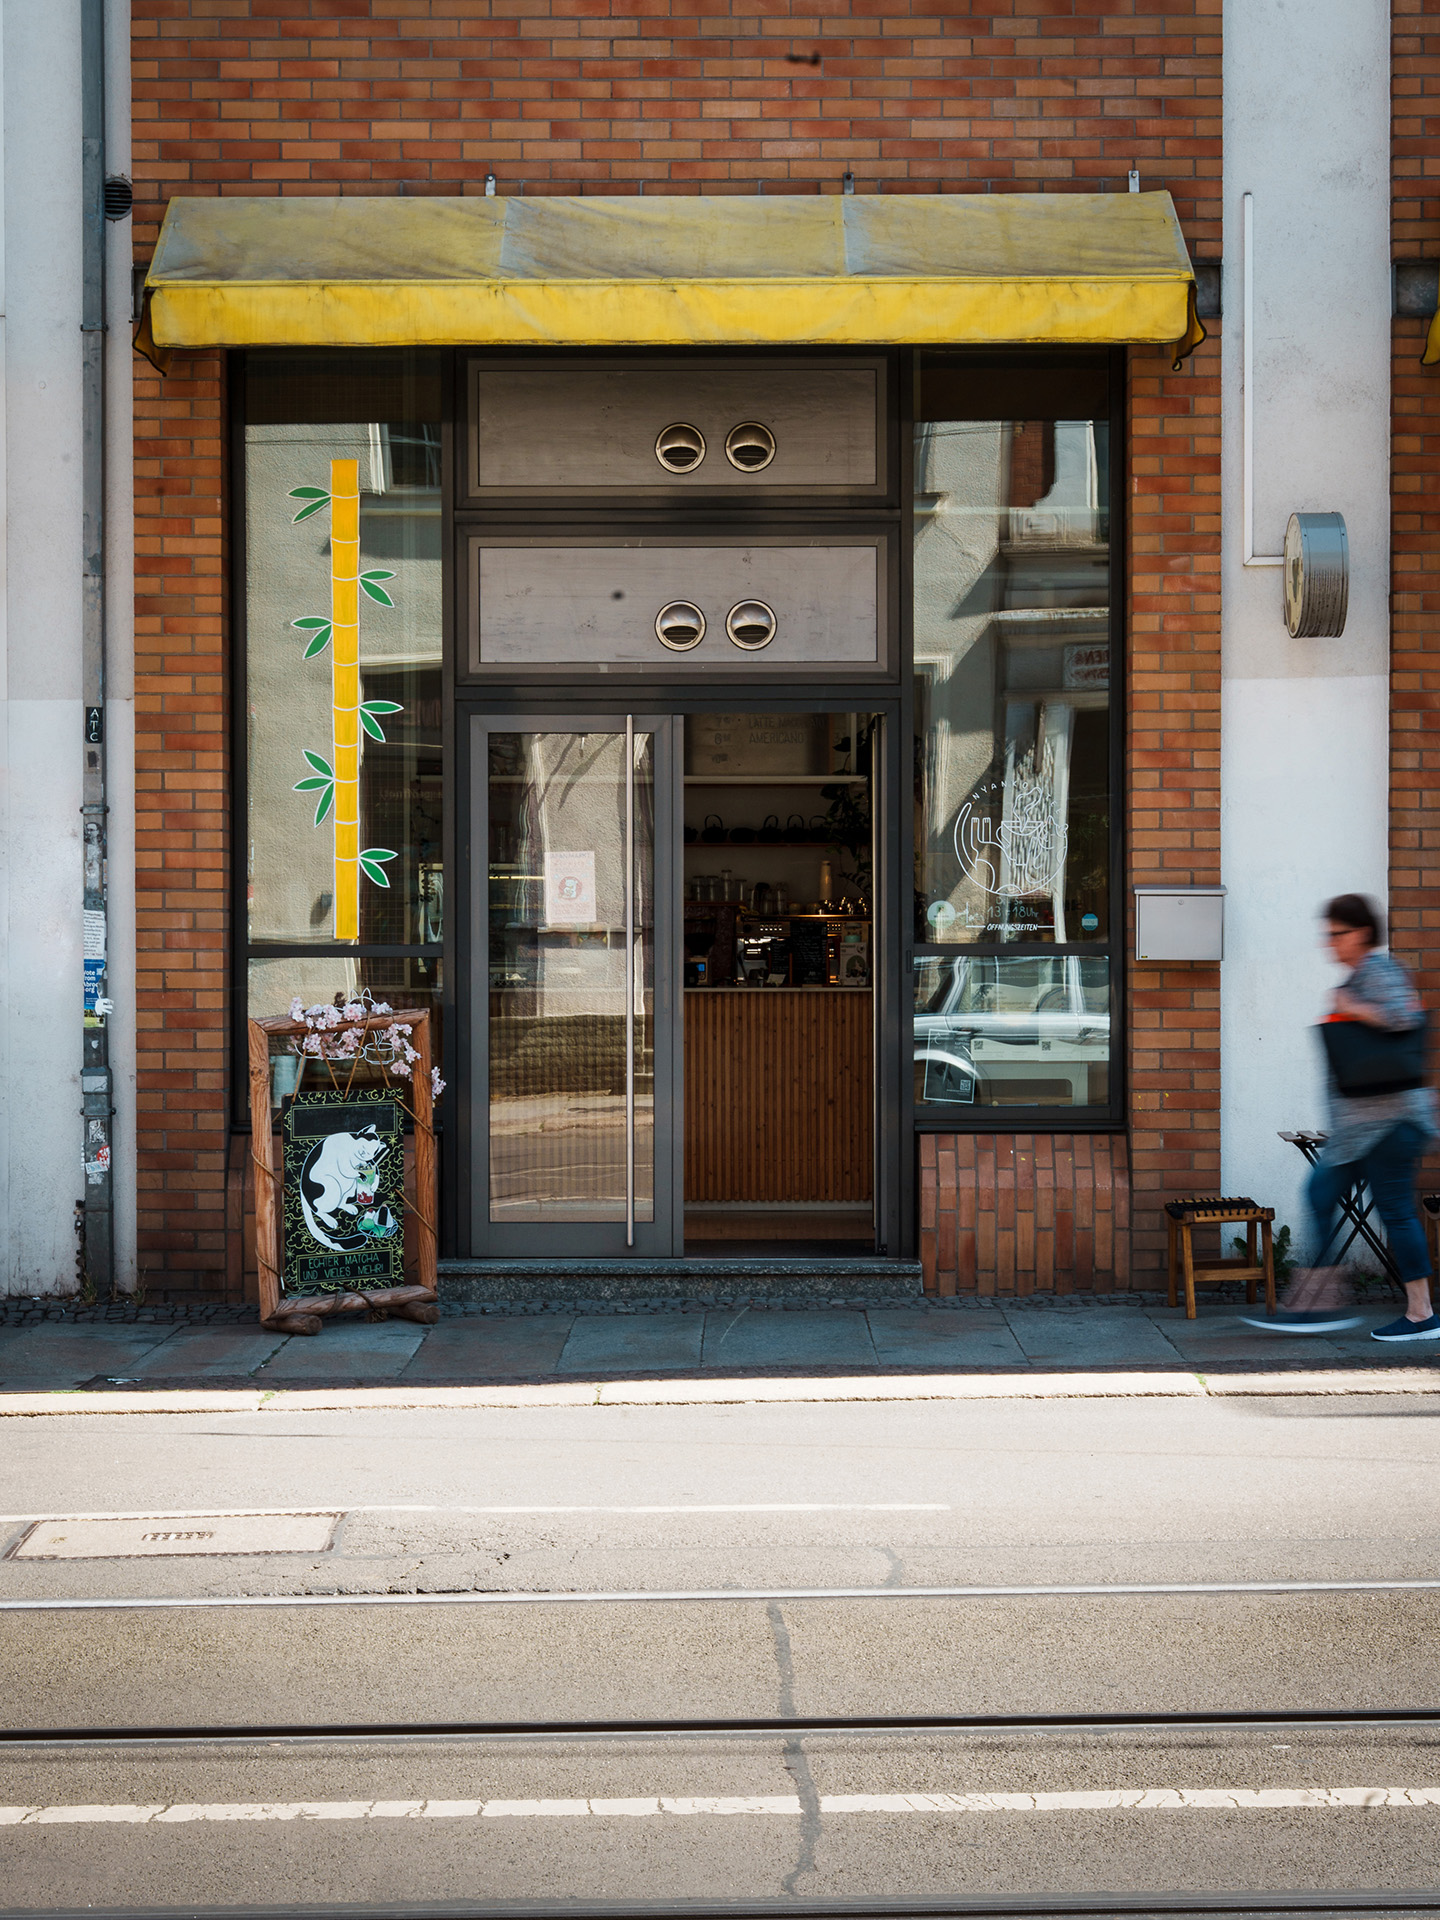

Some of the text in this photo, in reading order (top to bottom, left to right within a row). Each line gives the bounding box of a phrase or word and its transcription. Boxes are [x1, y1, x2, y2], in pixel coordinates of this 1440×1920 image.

[89, 708, 99, 742] ATC
[749, 716, 775, 728] LATTE
[749, 731, 805, 744] AMERICANO
[972, 780, 1028, 801] NYANKO
[987, 905, 1001, 918] 13
[308, 1252, 379, 1269] ECHTER MATCHA
[303, 1270, 318, 1281] UND
[357, 1263, 384, 1275] MEHR!
